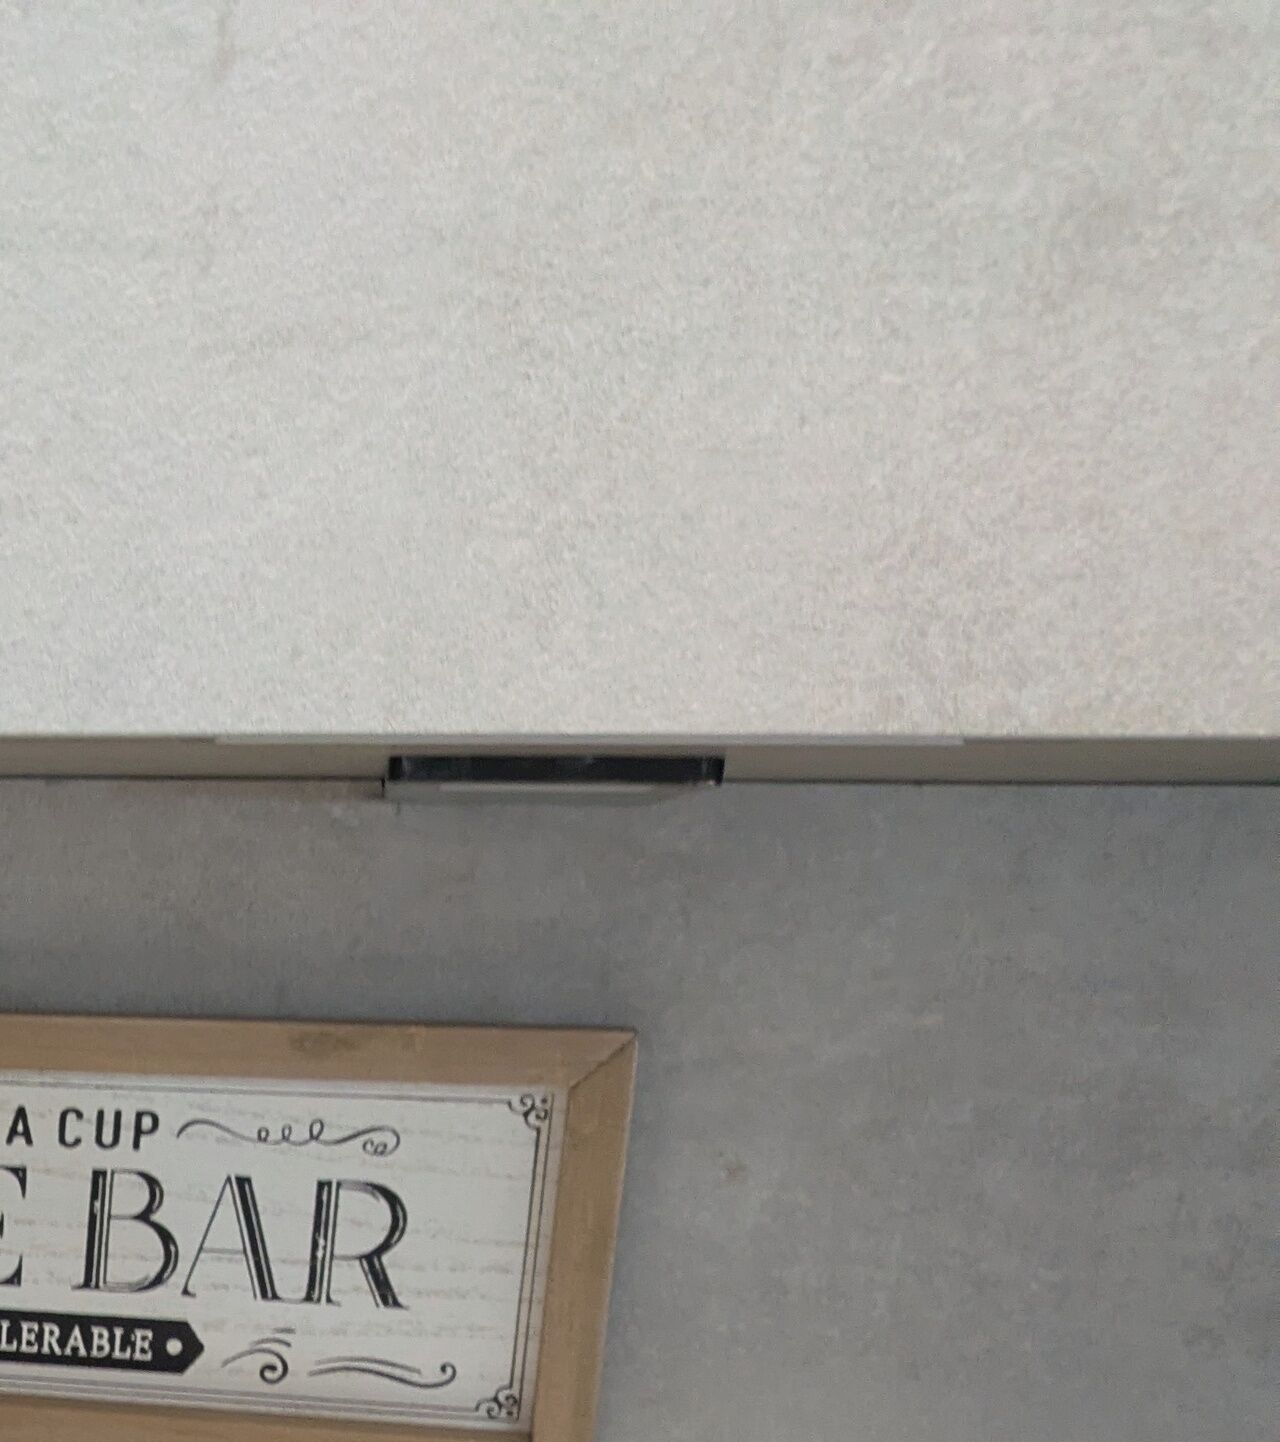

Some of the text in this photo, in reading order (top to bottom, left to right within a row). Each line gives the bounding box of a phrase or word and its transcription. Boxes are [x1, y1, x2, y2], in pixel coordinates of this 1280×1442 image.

[5, 1104, 34, 1147] A
[57, 1106, 160, 1152] CUP
[70, 1167, 410, 1310] BAR
